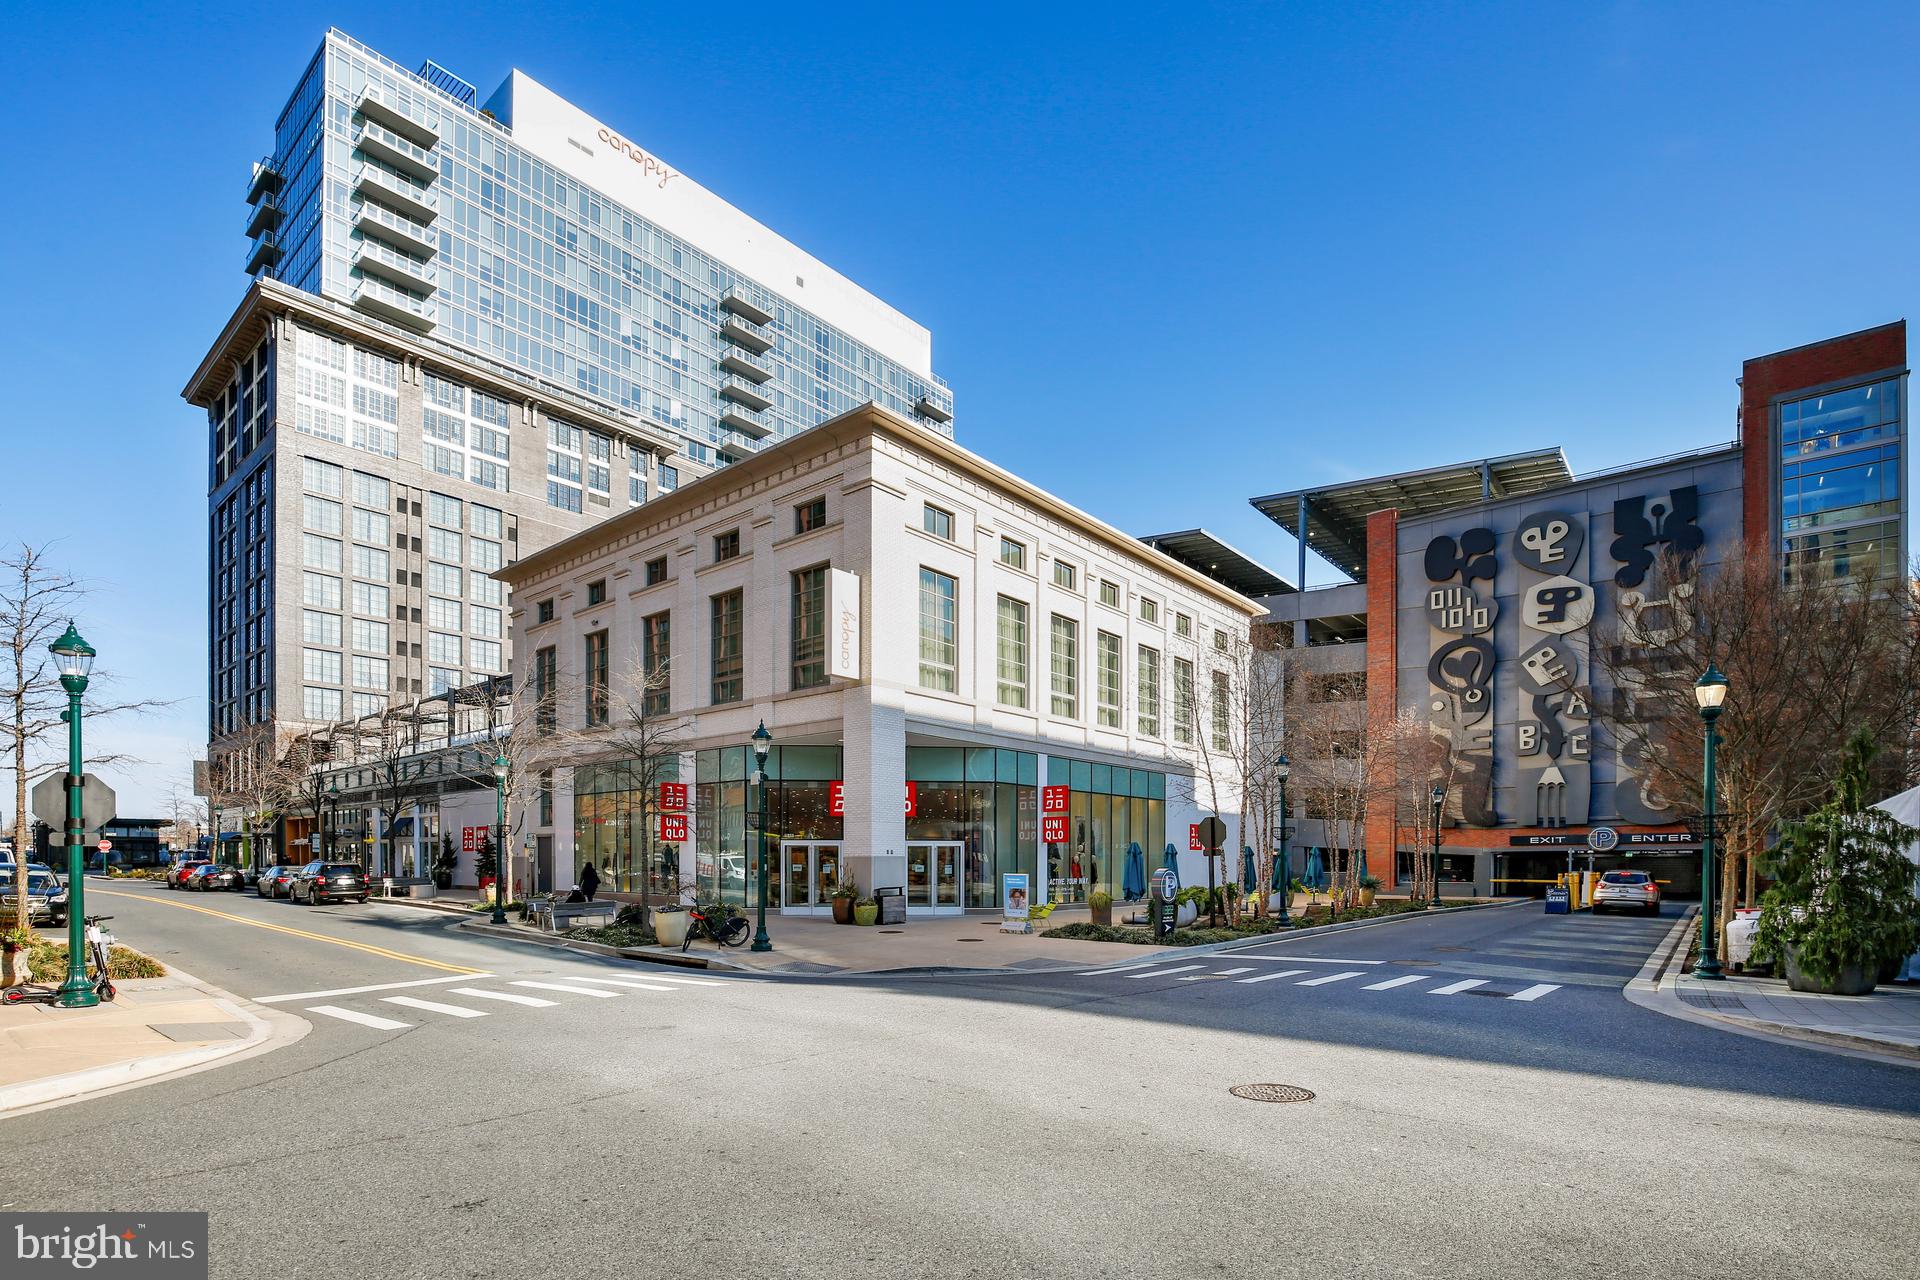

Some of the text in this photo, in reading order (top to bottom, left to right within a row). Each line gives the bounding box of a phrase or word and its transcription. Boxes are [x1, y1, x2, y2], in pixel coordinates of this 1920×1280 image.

[597, 128, 679, 189] canopy
[840, 600, 857, 670] canopy
[1519, 725, 1536, 750] B
[665, 817, 684, 827] UNI
[1045, 819, 1063, 829] UNI
[665, 828, 685, 839] QLO
[1045, 830, 1064, 841] QLO
[1631, 834, 1692, 843] ENTER
[1529, 836, 1566, 844] EXIT
[1595, 831, 1612, 848] P
[1165, 875, 1176, 897] P
